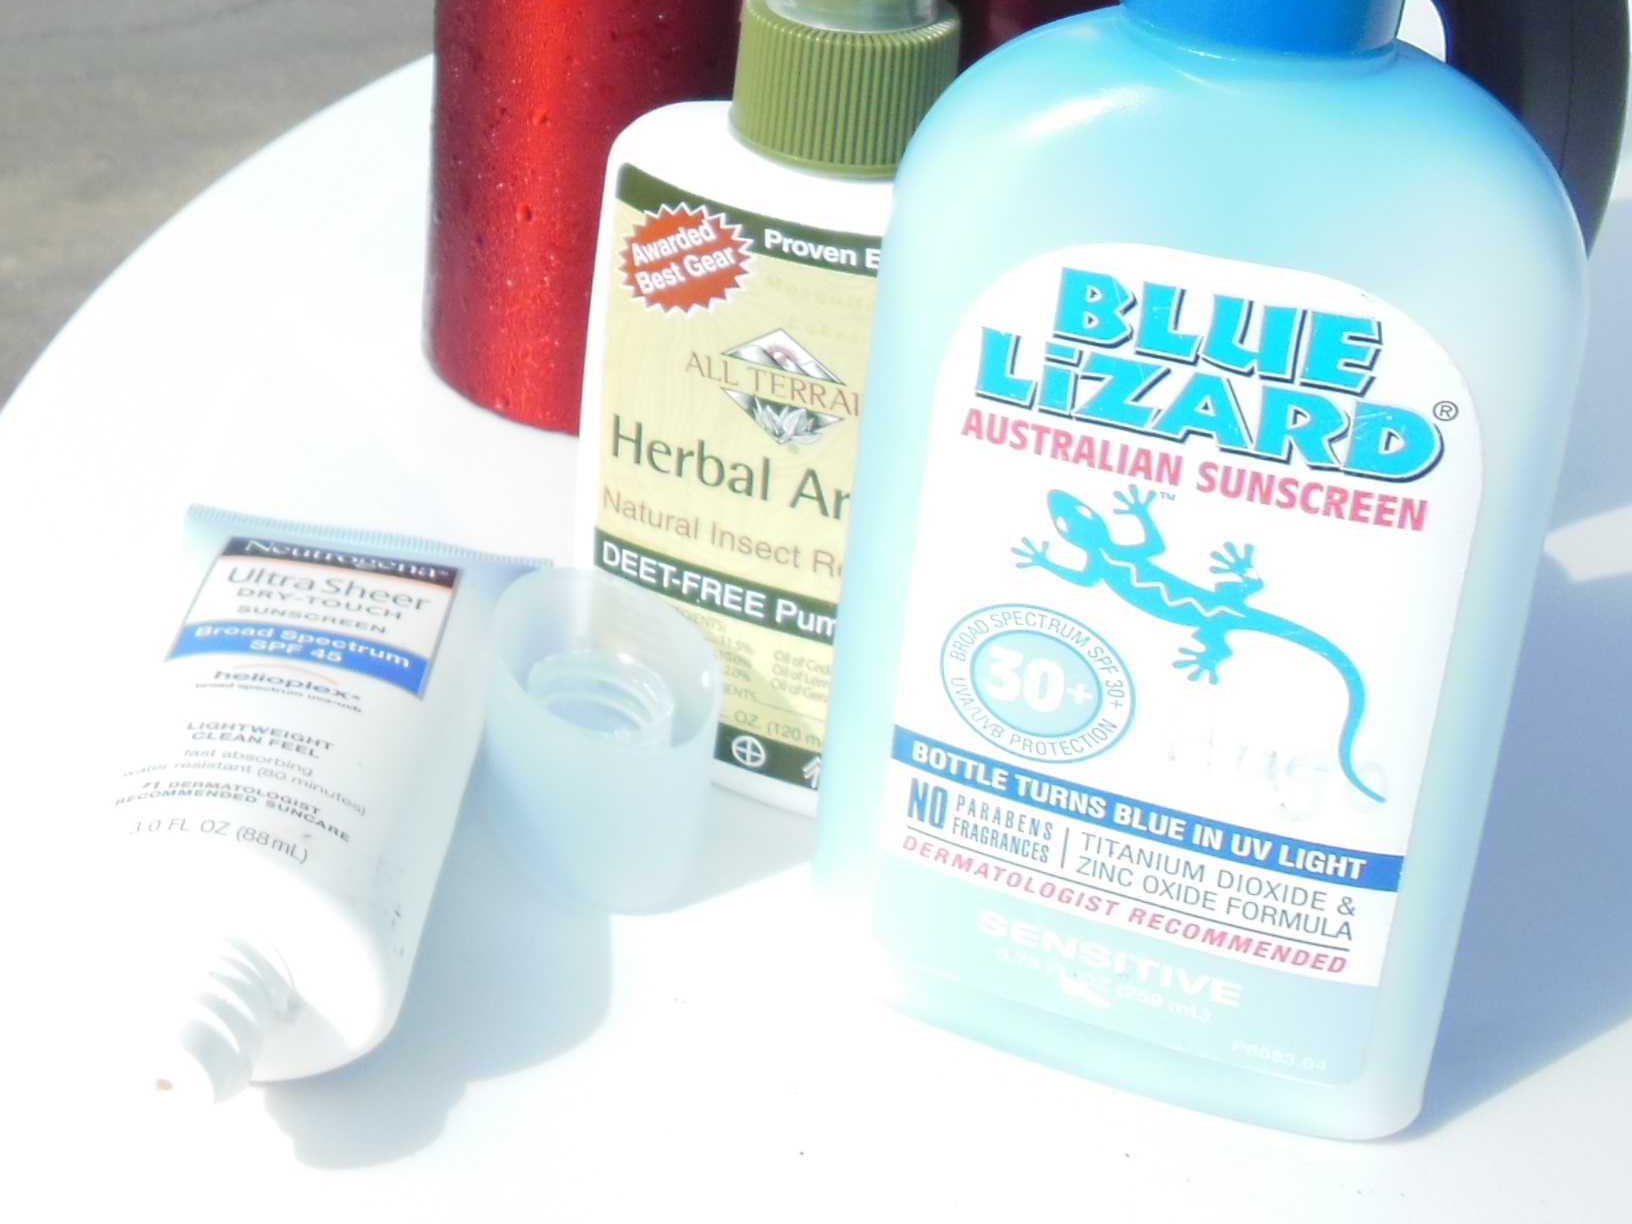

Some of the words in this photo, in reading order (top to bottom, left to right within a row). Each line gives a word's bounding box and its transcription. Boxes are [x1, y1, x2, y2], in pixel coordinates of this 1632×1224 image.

[631, 219, 716, 267] Awarded
[764, 228, 857, 267] Proven
[635, 262, 685, 295] Best
[683, 245, 737, 277] Gear
[1052, 266, 1383, 396] BLUE
[685, 351, 738, 388] ALL
[611, 413, 771, 502] Herbal
[961, 407, 1184, 486] AUSTRALIAN
[1196, 460, 1428, 532] SUNSCREEN
[603, 486, 699, 540] Natural
[710, 521, 800, 568] Insect
[245, 540, 436, 580] Neutrogena
[602, 540, 768, 618] DEET-FREE
[228, 567, 316, 592] Ultra
[321, 578, 430, 610] Sheer
[237, 588, 402, 620] DRY-TOUCH
[237, 605, 387, 634] SUNSCREEN
[950, 619, 989, 661] BROAD
[990, 610, 1090, 648] SPECTRUM
[1087, 646, 1119, 675] SPF
[195, 625, 275, 638] Broad
[280, 629, 410, 668] Spectrum
[249, 639, 304, 655] SPF
[310, 648, 343, 663] 45
[983, 645, 1093, 713] 30+
[187, 721, 334, 752] LIGHTWEIGHT
[191, 732, 262, 746] CLEAN
[268, 738, 319, 758] FEEL
[1009, 717, 1118, 757] PROTECTION
[174, 761, 252, 774] resistant
[221, 751, 313, 777] absorbing
[115, 789, 257, 806] RECOMMENDED
[265, 799, 351, 843] SUNCARE
[168, 781, 322, 815] DERMATOLOGIST
[907, 777, 948, 830] NO
[956, 793, 1054, 842] PARABENS
[912, 740, 1009, 791] BOTTLE
[1015, 774, 1106, 819] TURNS
[1113, 802, 1188, 841] BLUE
[1192, 823, 1224, 851] IN
[1230, 833, 1273, 862] UV
[1278, 844, 1367, 880] LIGHT
[168, 818, 190, 832] FL
[200, 819, 230, 836] OZ
[952, 817, 1050, 864] FRAGRANCES
[1076, 855, 1134, 888] ZINC
[1143, 876, 1218, 912] OXIDE
[1226, 896, 1353, 941] FORMULA
[1081, 831, 1205, 883] TITANIUM
[1217, 869, 1328, 912] DIOXIDE
[1336, 895, 1357, 918] &
[902, 834, 1120, 917] DERMATOLOGIST
[1128, 908, 1348, 974] RECOMMENDED
[977, 909, 1243, 1008] SENSITIVE
